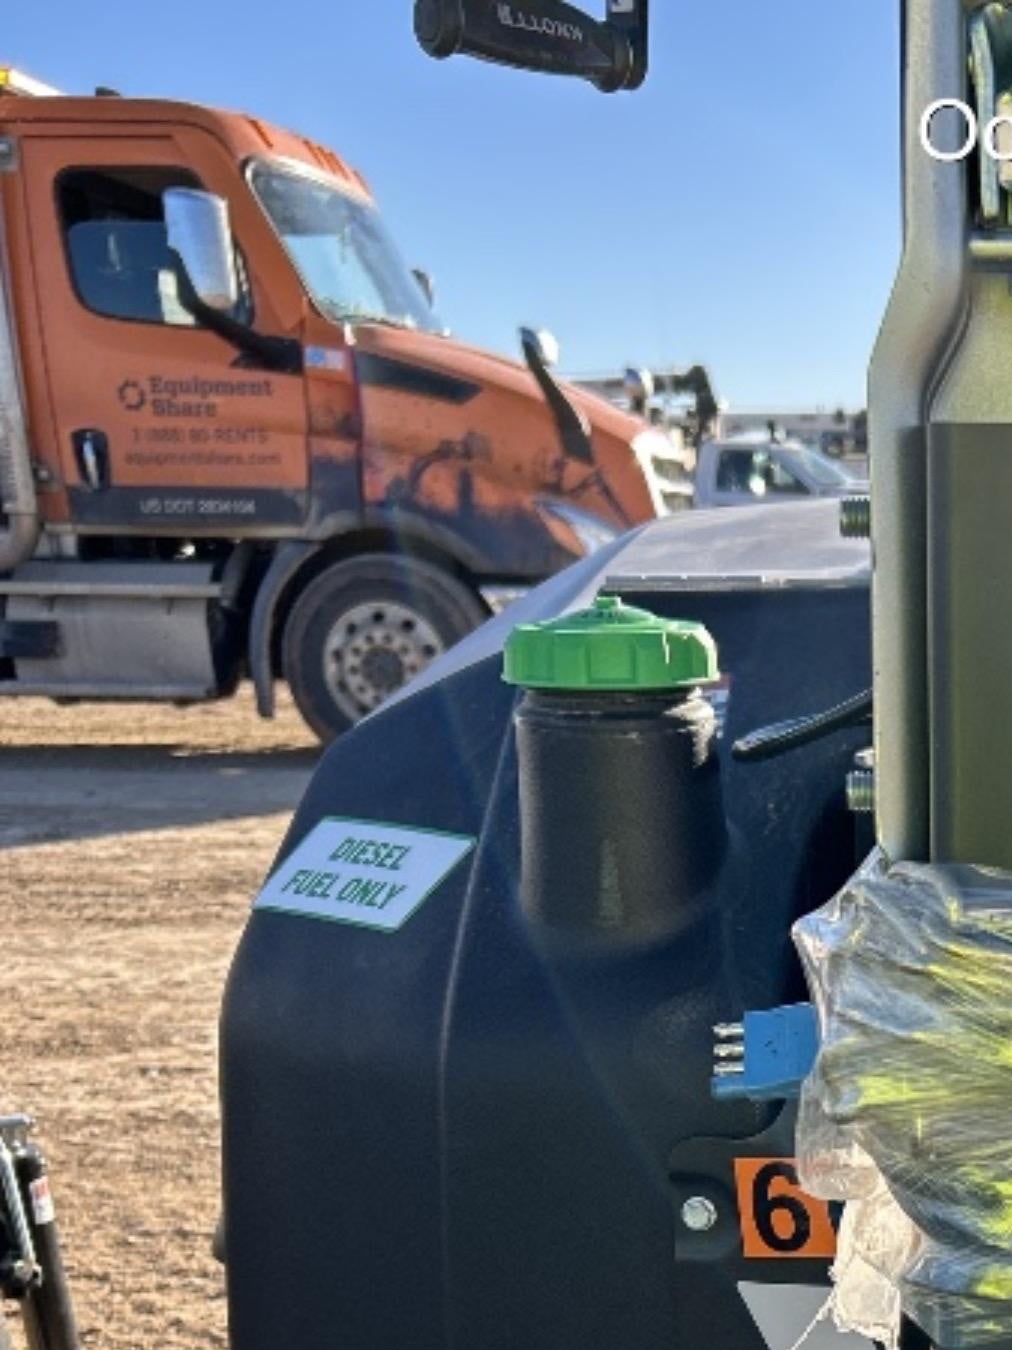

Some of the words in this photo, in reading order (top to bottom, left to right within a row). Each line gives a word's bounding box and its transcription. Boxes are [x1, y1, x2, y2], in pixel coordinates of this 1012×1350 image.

[148, 376, 273, 399] Equipment
[150, 399, 218, 418] Share
[140, 498, 162, 514] US
[164, 498, 195, 514] DOT
[328, 836, 412, 871] DIESEL
[280, 869, 340, 899] FUEL
[336, 877, 407, 910] ONLY
[752, 1161, 843, 1252] 6
